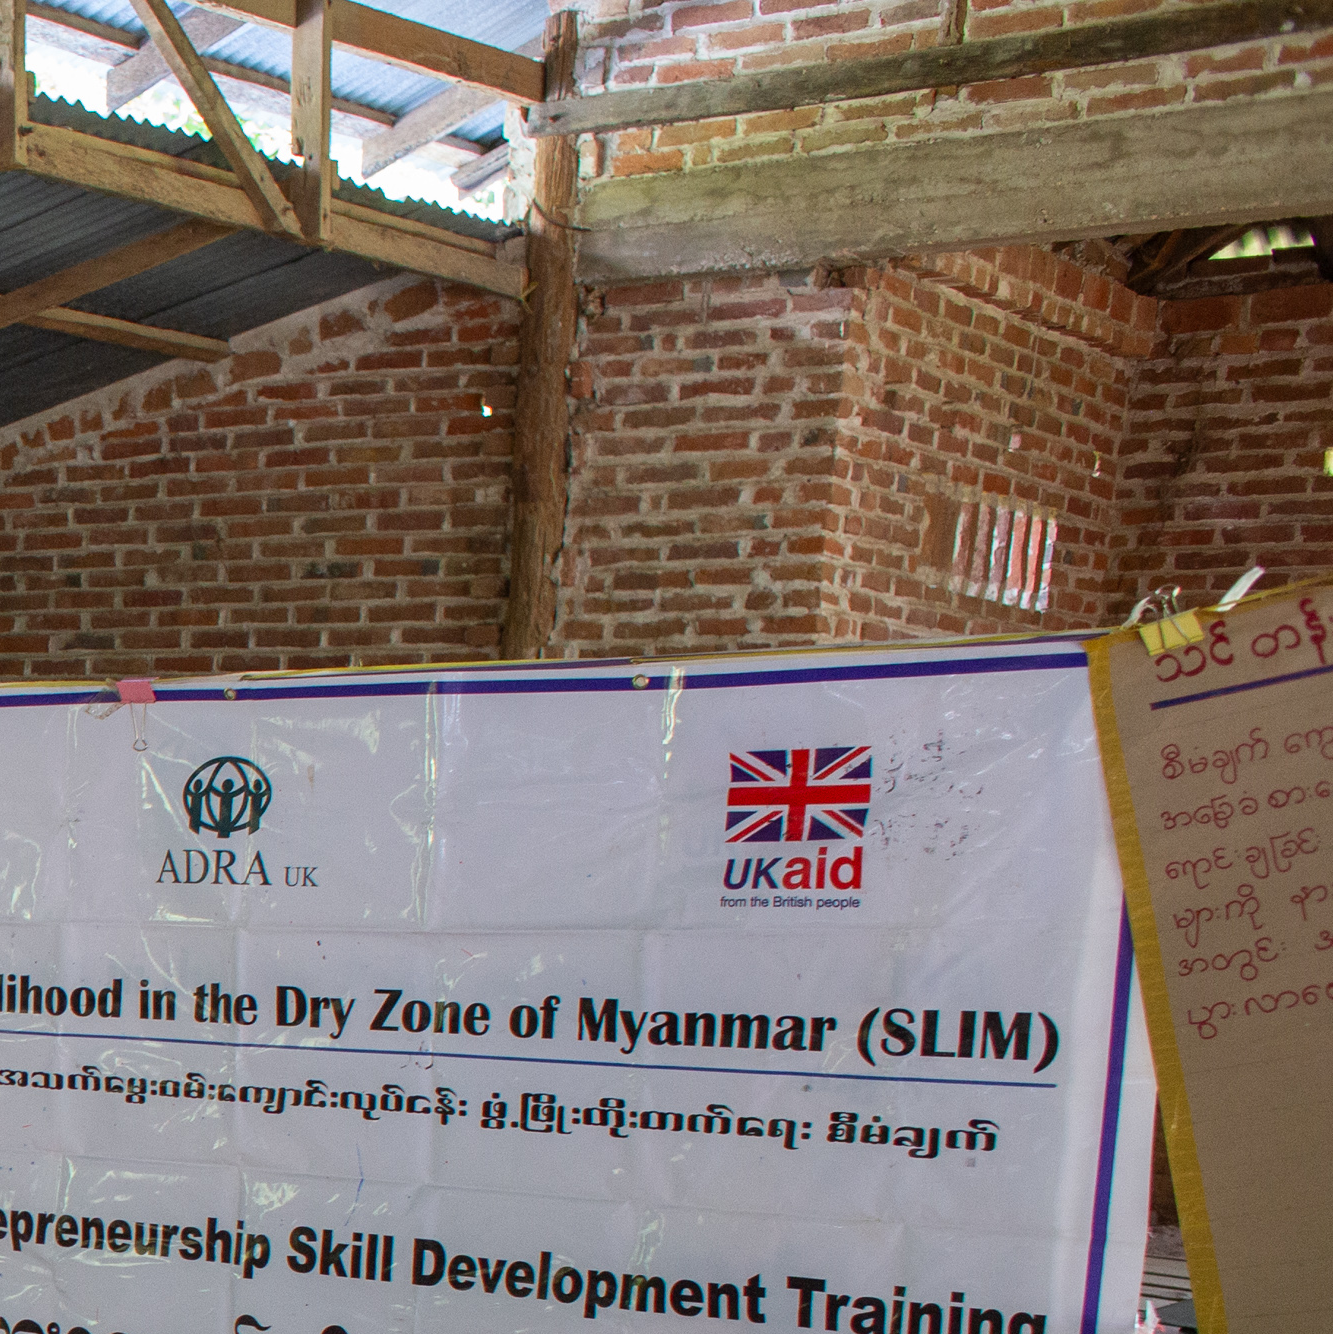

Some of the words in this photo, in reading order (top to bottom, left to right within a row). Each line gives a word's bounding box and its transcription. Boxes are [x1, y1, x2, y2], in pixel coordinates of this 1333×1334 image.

[156, 849, 272, 886] ADRA
[284, 866, 318, 888] UK
[720, 895, 748, 908] from
[750, 896, 770, 908] the
[772, 895, 813, 908] British
[816, 896, 861, 911] people
[139, 979, 177, 1021] in
[193, 982, 258, 1026] the
[276, 985, 356, 1040] Dry
[370, 988, 491, 1036] Zone
[509, 995, 561, 1040] of
[578, 997, 838, 1055] Myanmar
[857, 1007, 1059, 1074] (SLIM)
[826, 1111, 998, 1159] စီမံချက်
[287, 1226, 394, 1282] Skill
[412, 1238, 767, 1324] Development
